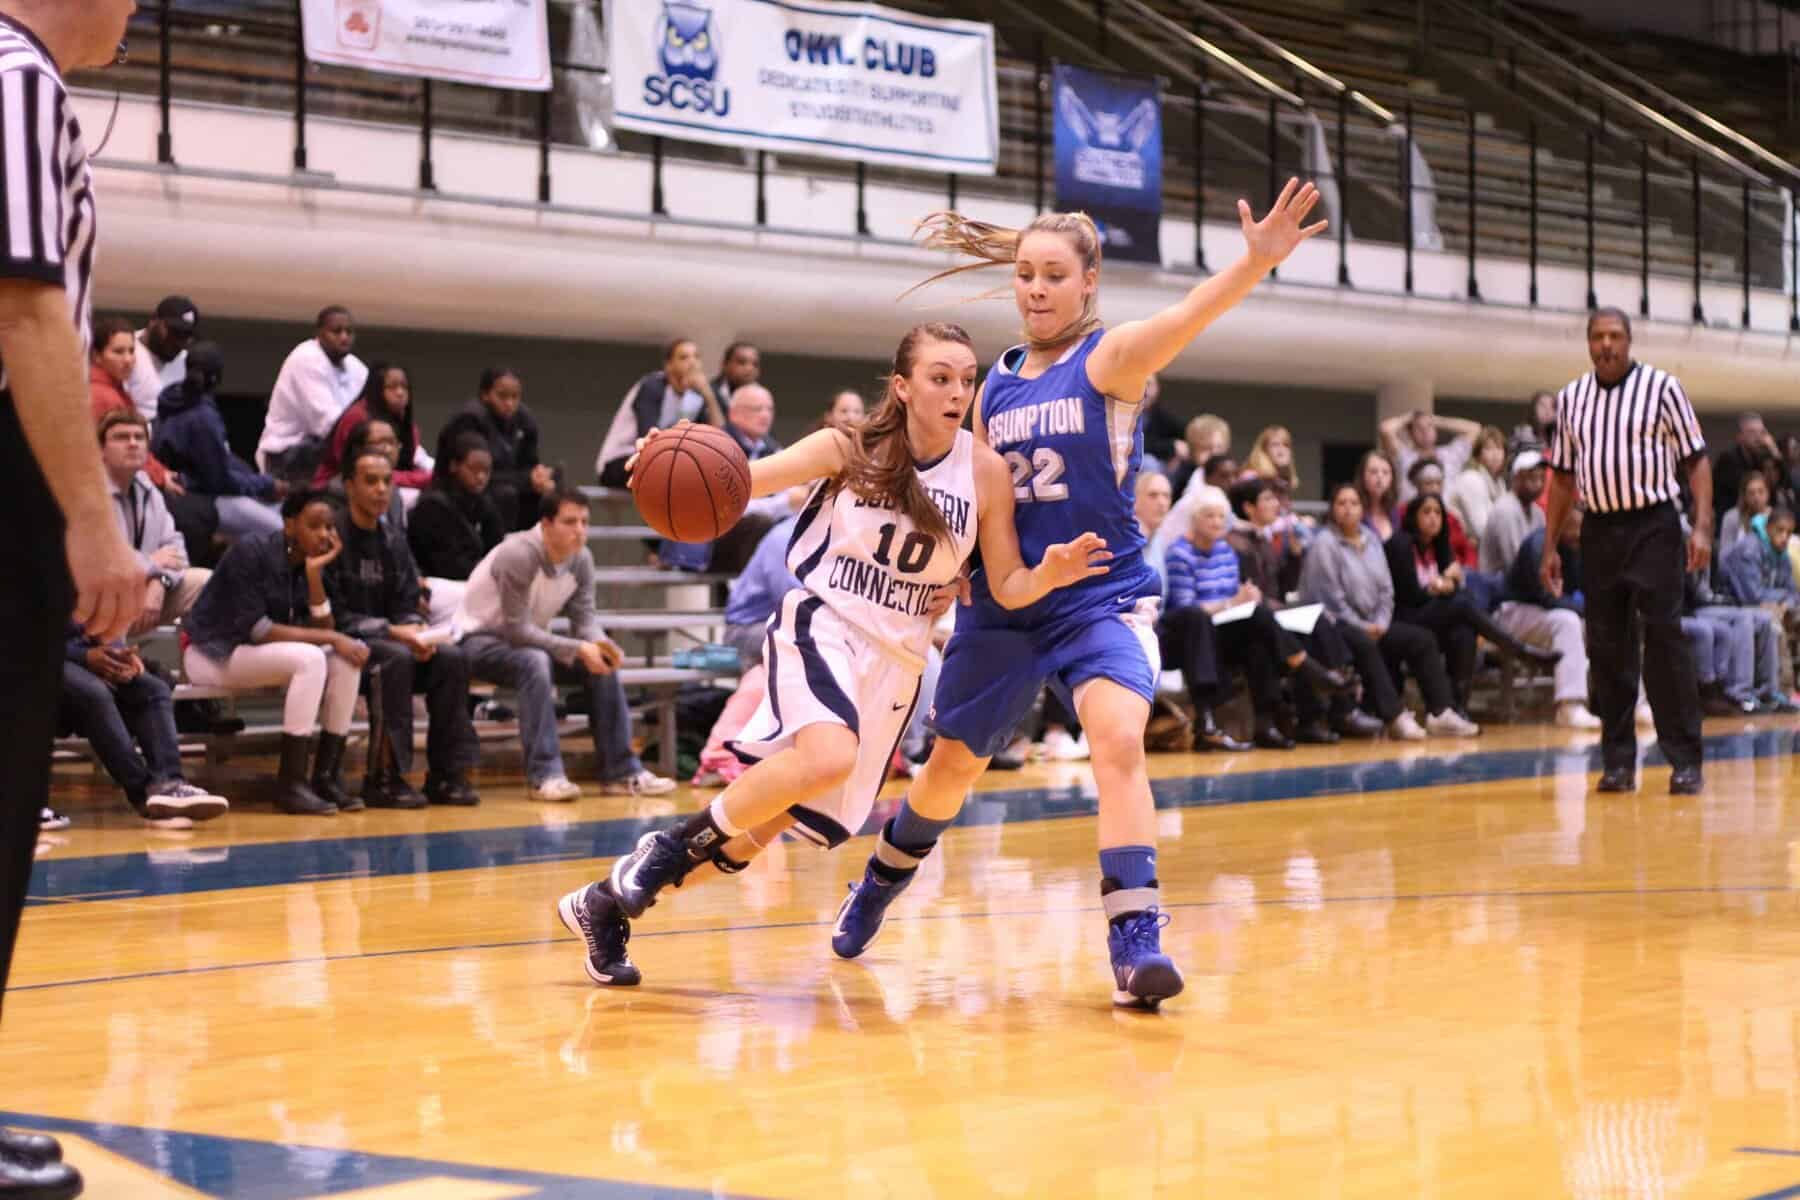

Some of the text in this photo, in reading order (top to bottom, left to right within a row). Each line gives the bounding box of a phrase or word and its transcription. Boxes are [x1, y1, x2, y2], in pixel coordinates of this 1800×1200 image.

[785, 29, 936, 78] OWL CLUB
[644, 75, 729, 117] SCSU
[987, 398, 1085, 448] SSUMPTION
[1004, 448, 1069, 503] 22
[873, 523, 936, 573] 10
[828, 555, 943, 616] CONNECTIC
